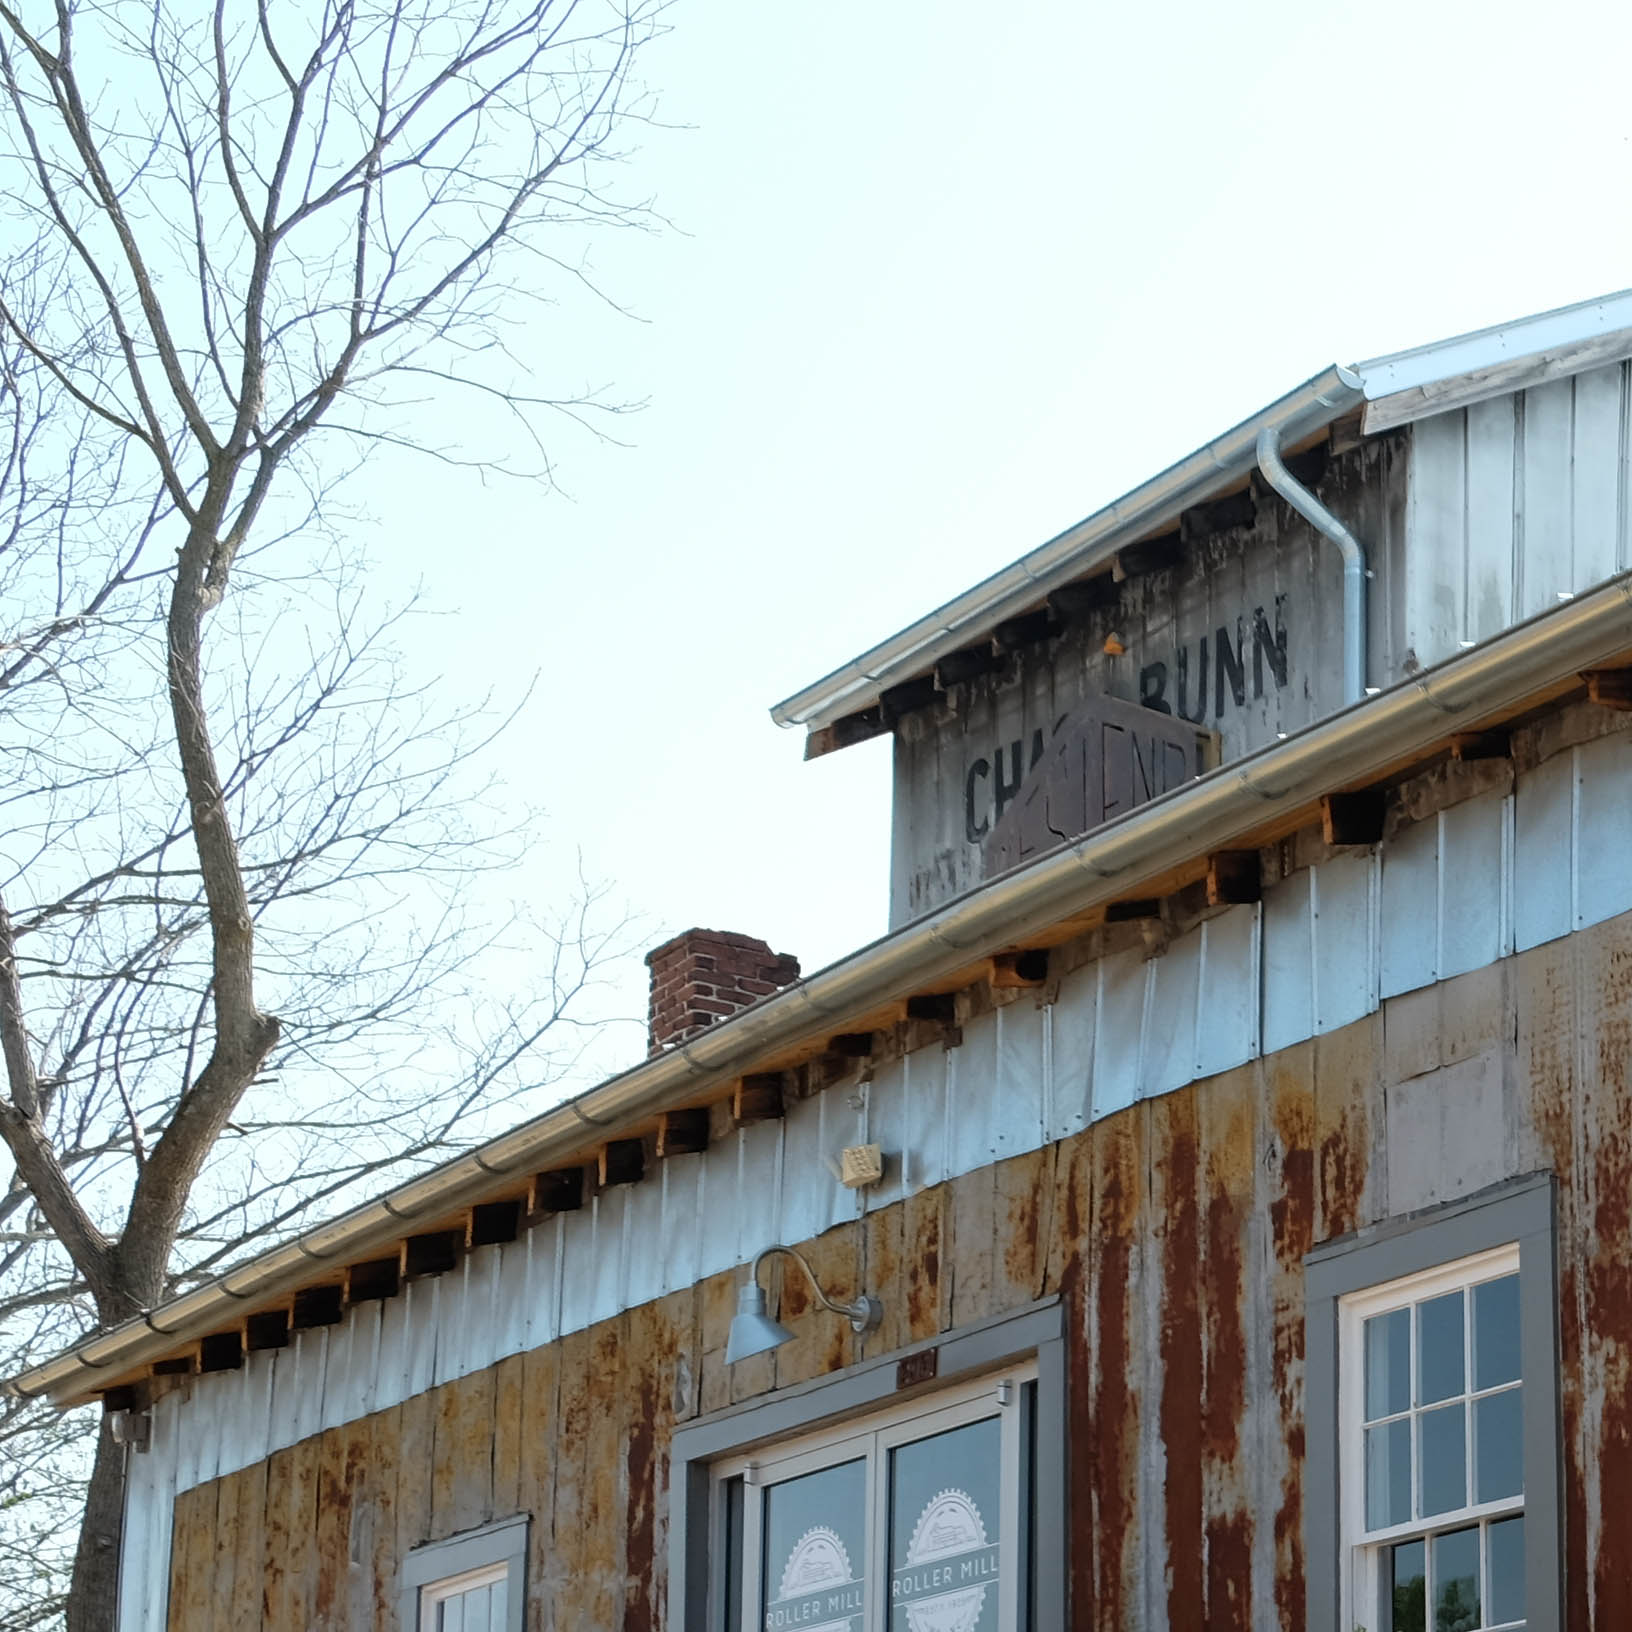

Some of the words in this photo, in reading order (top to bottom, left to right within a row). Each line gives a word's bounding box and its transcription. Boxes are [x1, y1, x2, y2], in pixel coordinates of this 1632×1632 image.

[892, 1566, 953, 1598] ROLLER
[960, 1555, 998, 1580] MILL
[766, 1600, 821, 1629] ROLLER
[828, 1590, 863, 1613] MILL
